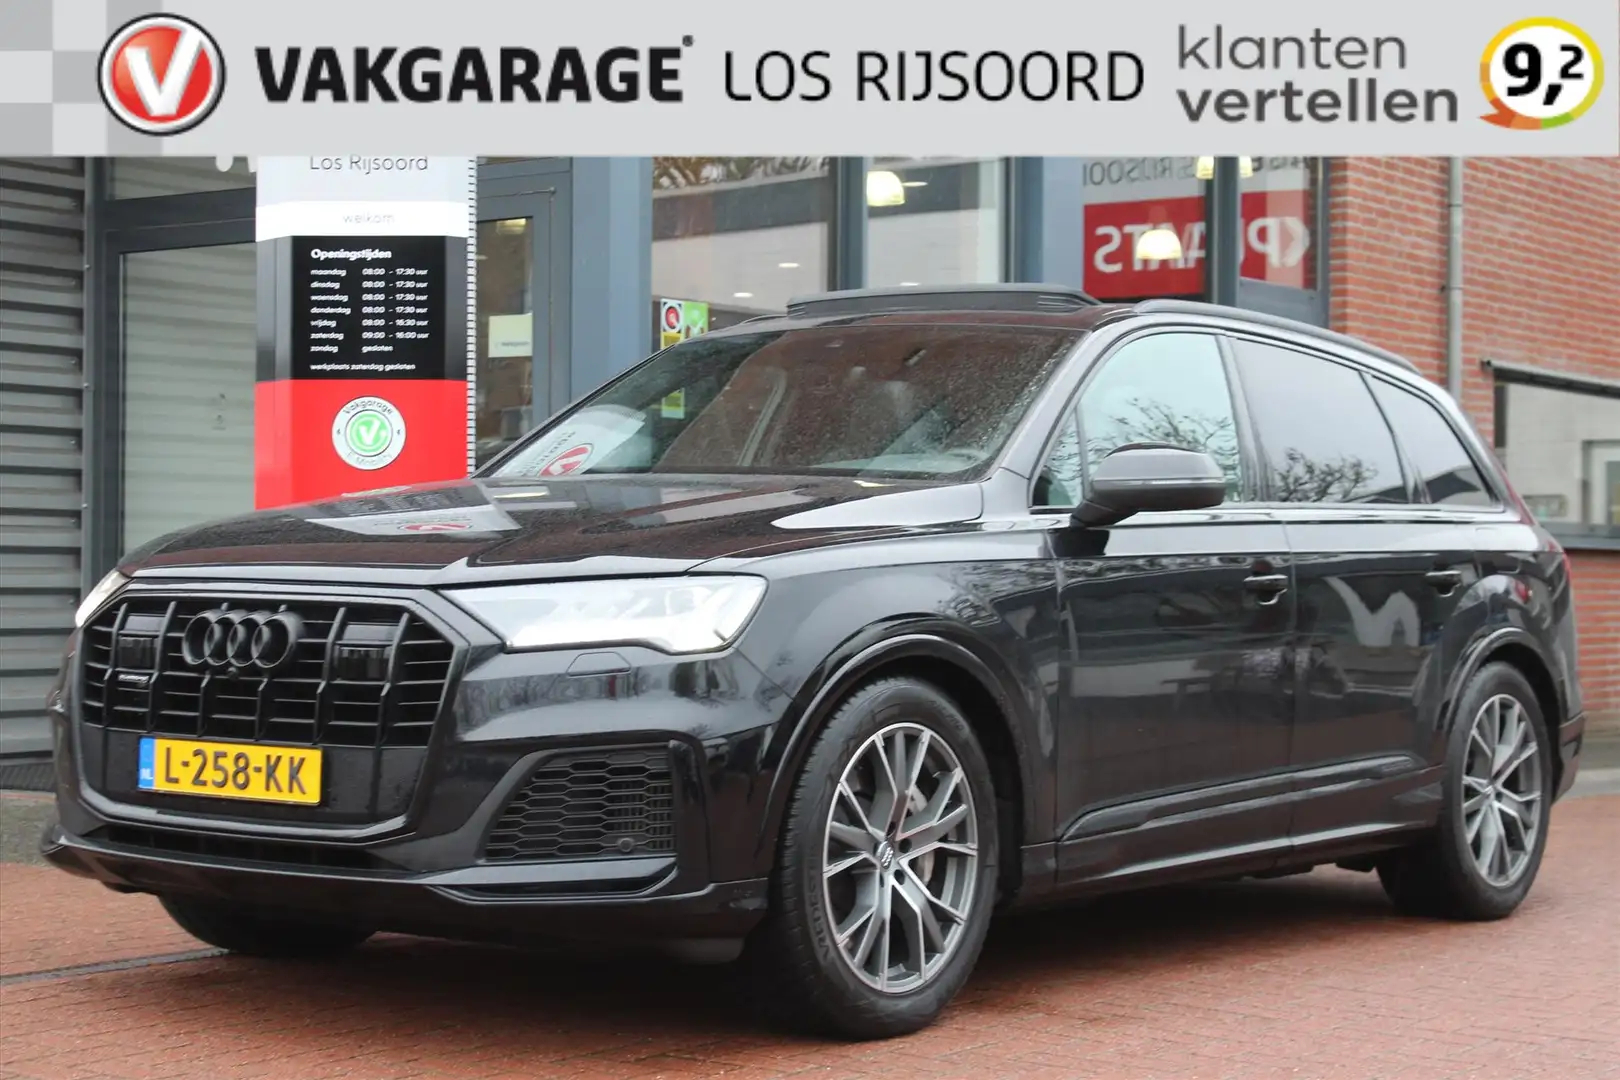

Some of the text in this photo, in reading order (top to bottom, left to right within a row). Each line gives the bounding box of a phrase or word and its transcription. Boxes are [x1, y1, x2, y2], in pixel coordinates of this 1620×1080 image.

[310, 155, 428, 174] Los Rijsoord
[342, 211, 394, 224] welkom
[310, 248, 393, 262] Openingstijden
[310, 267, 347, 277] maandag
[310, 280, 341, 290] dinsdag
[310, 306, 352, 315] donderdag
[310, 318, 337, 328] vrijdag
[310, 331, 345, 341] zaterdag
[310, 344, 339, 354] zondag
[164, 746, 308, 796] L-258-KK
